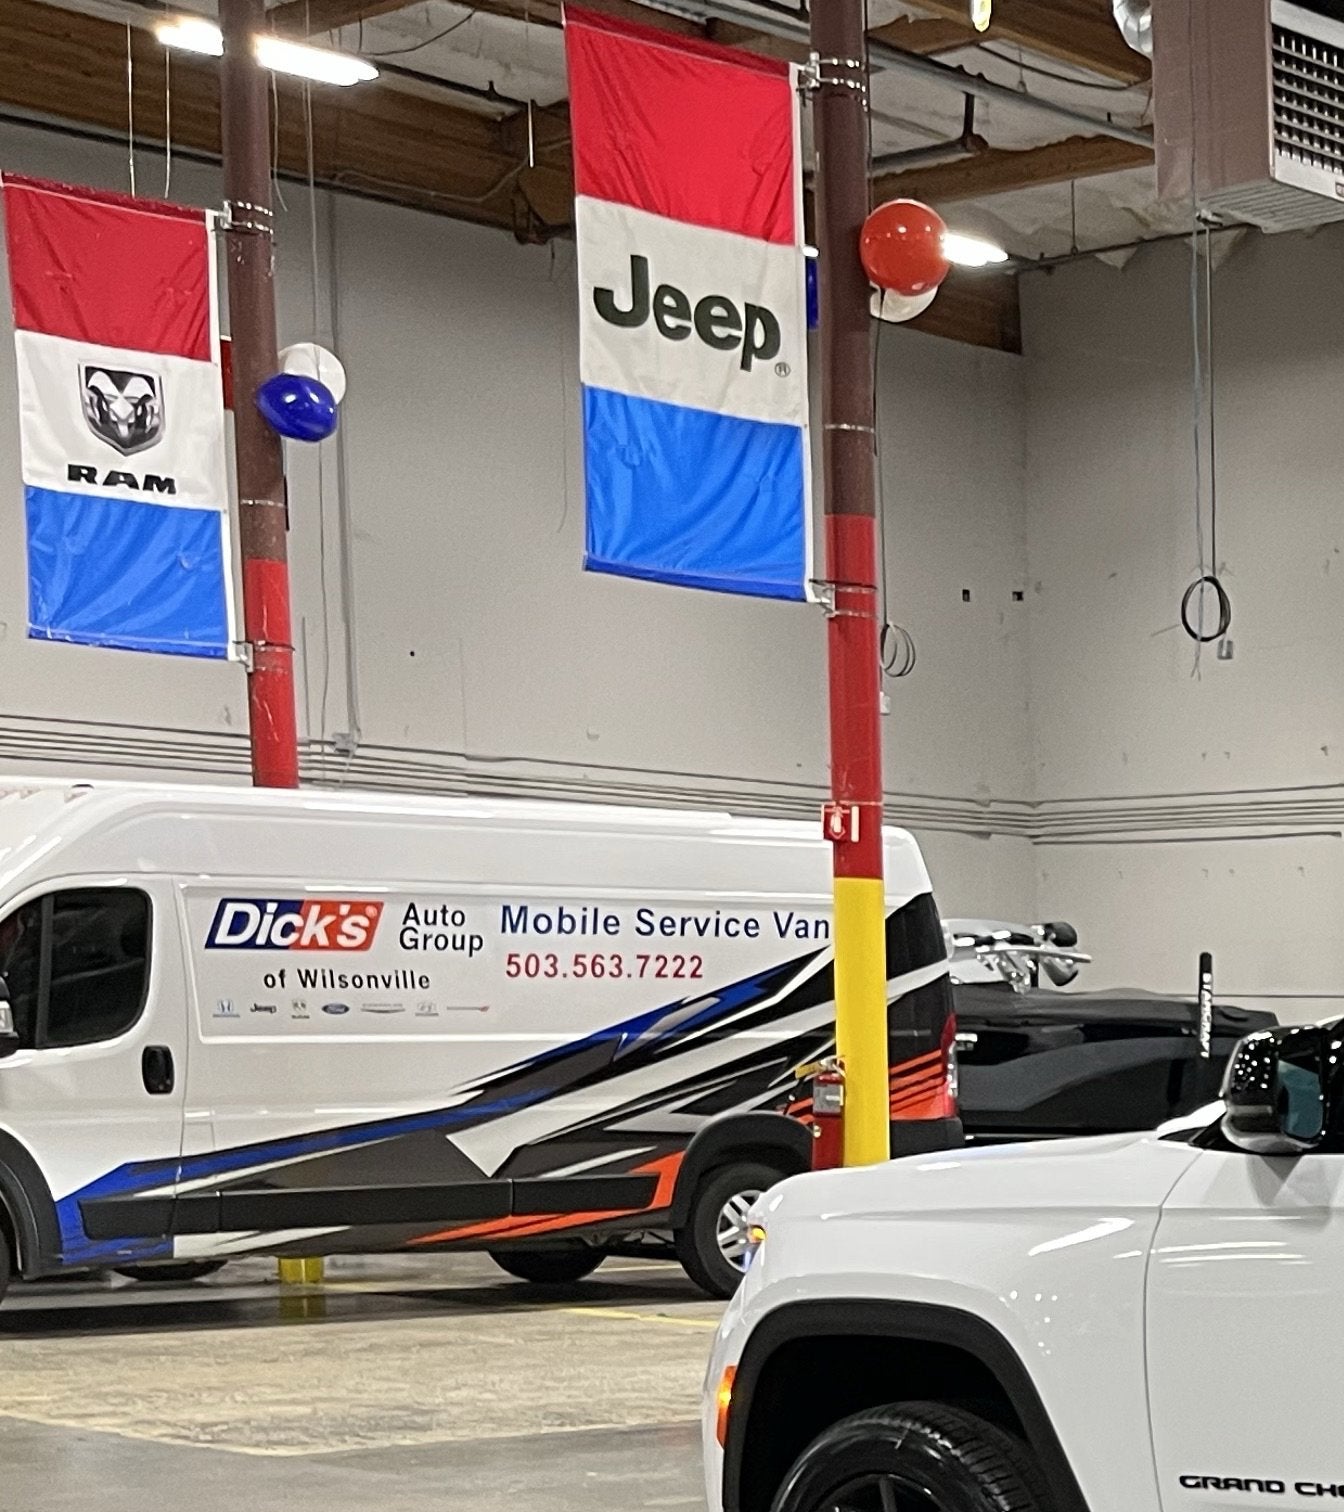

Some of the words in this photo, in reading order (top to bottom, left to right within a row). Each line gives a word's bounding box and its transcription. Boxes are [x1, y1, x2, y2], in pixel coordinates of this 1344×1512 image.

[593, 254, 781, 372] Jeep
[67, 463, 177, 495] RAM
[402, 902, 466, 928] Auto
[500, 904, 620, 936] Mobile
[635, 906, 761, 939] Service
[773, 911, 830, 940] Van
[399, 926, 484, 957] Group
[262, 968, 287, 989] of
[297, 968, 431, 989] Wilsonville
[505, 952, 704, 979] 503.563.7222
[1179, 1474, 1286, 1494] GRAND
